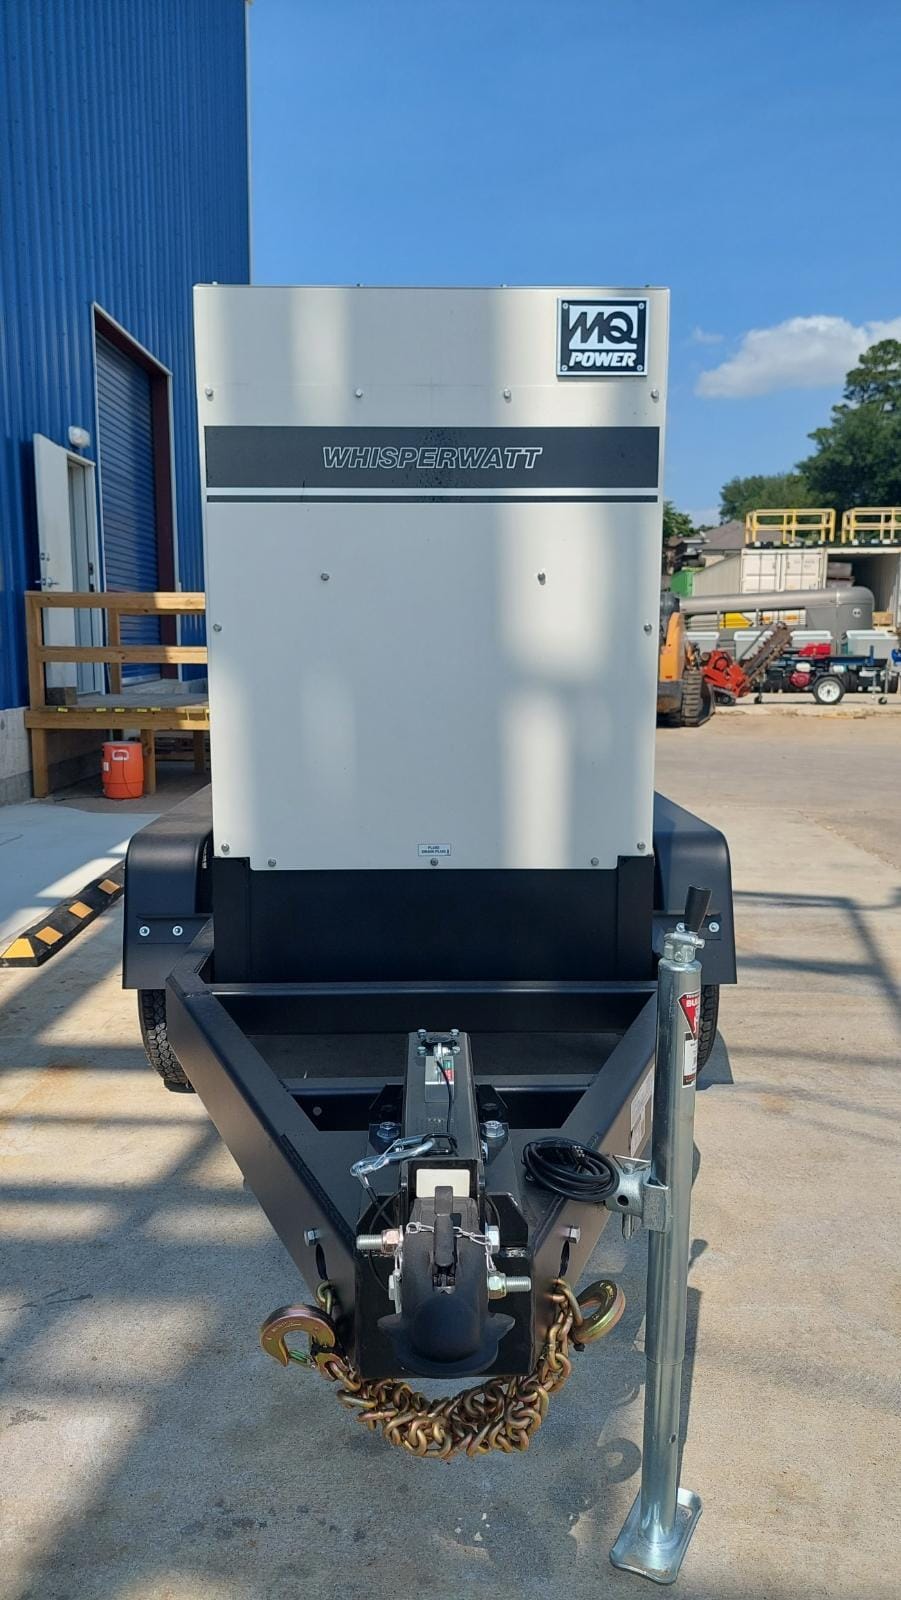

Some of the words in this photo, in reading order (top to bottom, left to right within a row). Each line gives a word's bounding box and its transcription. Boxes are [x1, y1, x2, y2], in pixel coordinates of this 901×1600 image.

[569, 311, 636, 345] MQ
[568, 351, 637, 367] POWER
[322, 447, 543, 469] WHISPERWATT
